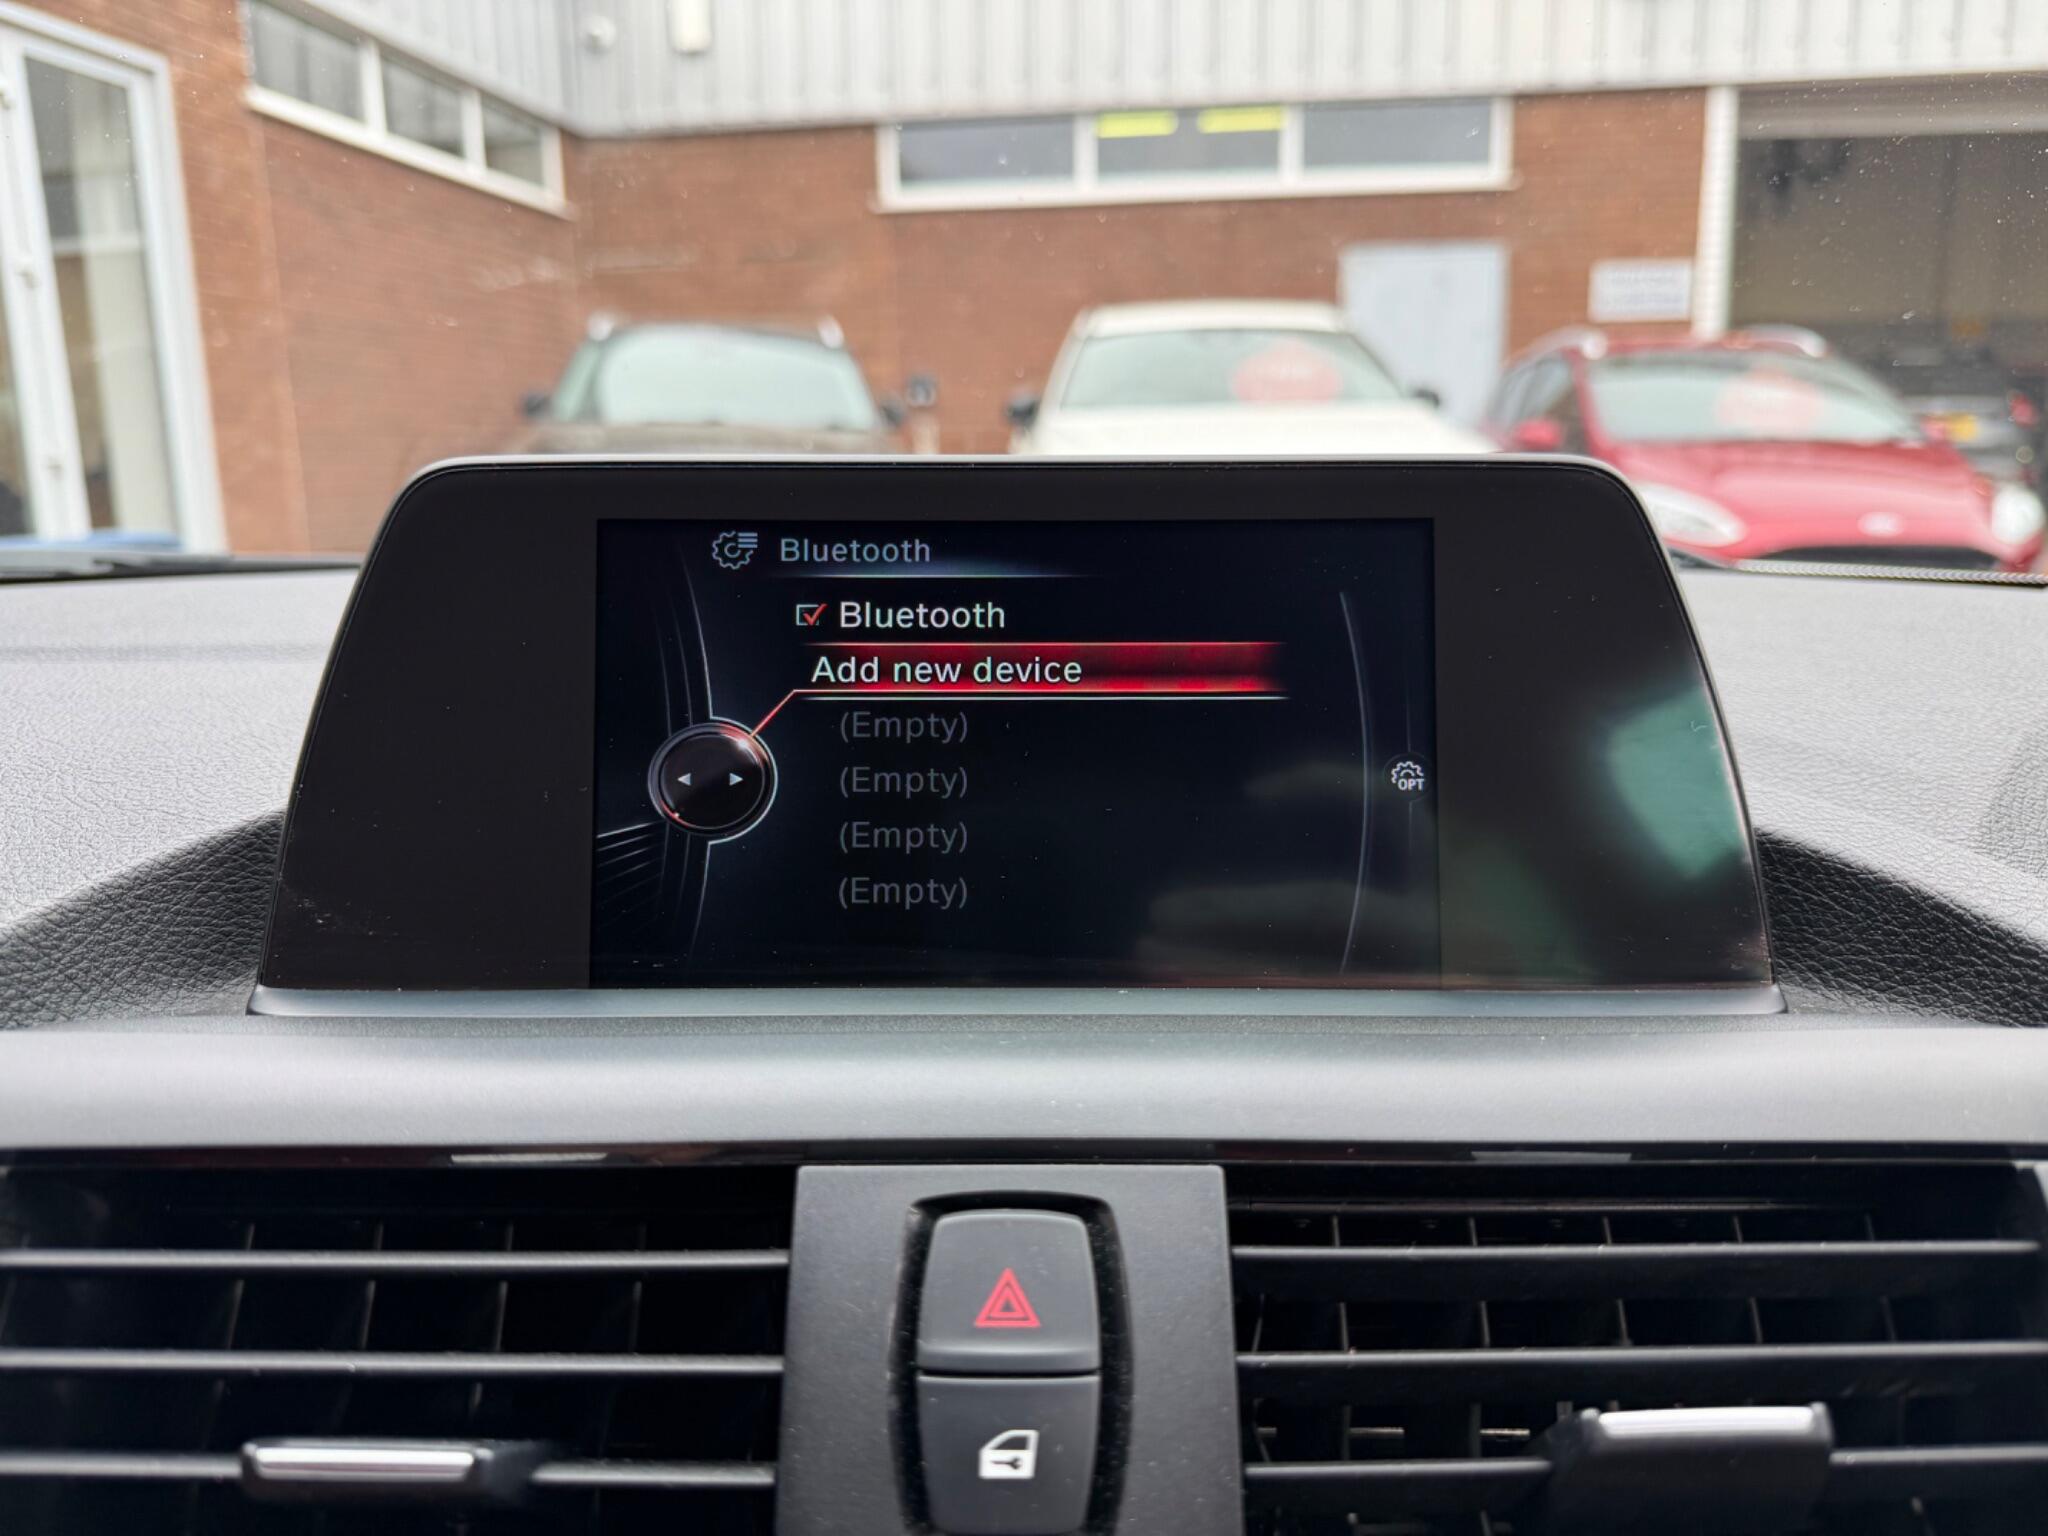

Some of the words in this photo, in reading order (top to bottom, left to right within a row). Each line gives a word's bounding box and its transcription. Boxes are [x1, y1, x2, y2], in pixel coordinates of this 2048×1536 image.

[780, 538, 931, 562] Bluetooth
[840, 601, 1005, 629] Bluetooth
[811, 656, 879, 683] Add
[893, 661, 962, 683] new
[973, 656, 1082, 683] device
[840, 710, 968, 744] (Empty)
[839, 766, 968, 799] (Empty)
[1397, 778, 1425, 791] OPT
[839, 821, 968, 855] (Empty)
[838, 876, 968, 910] (Empty)
